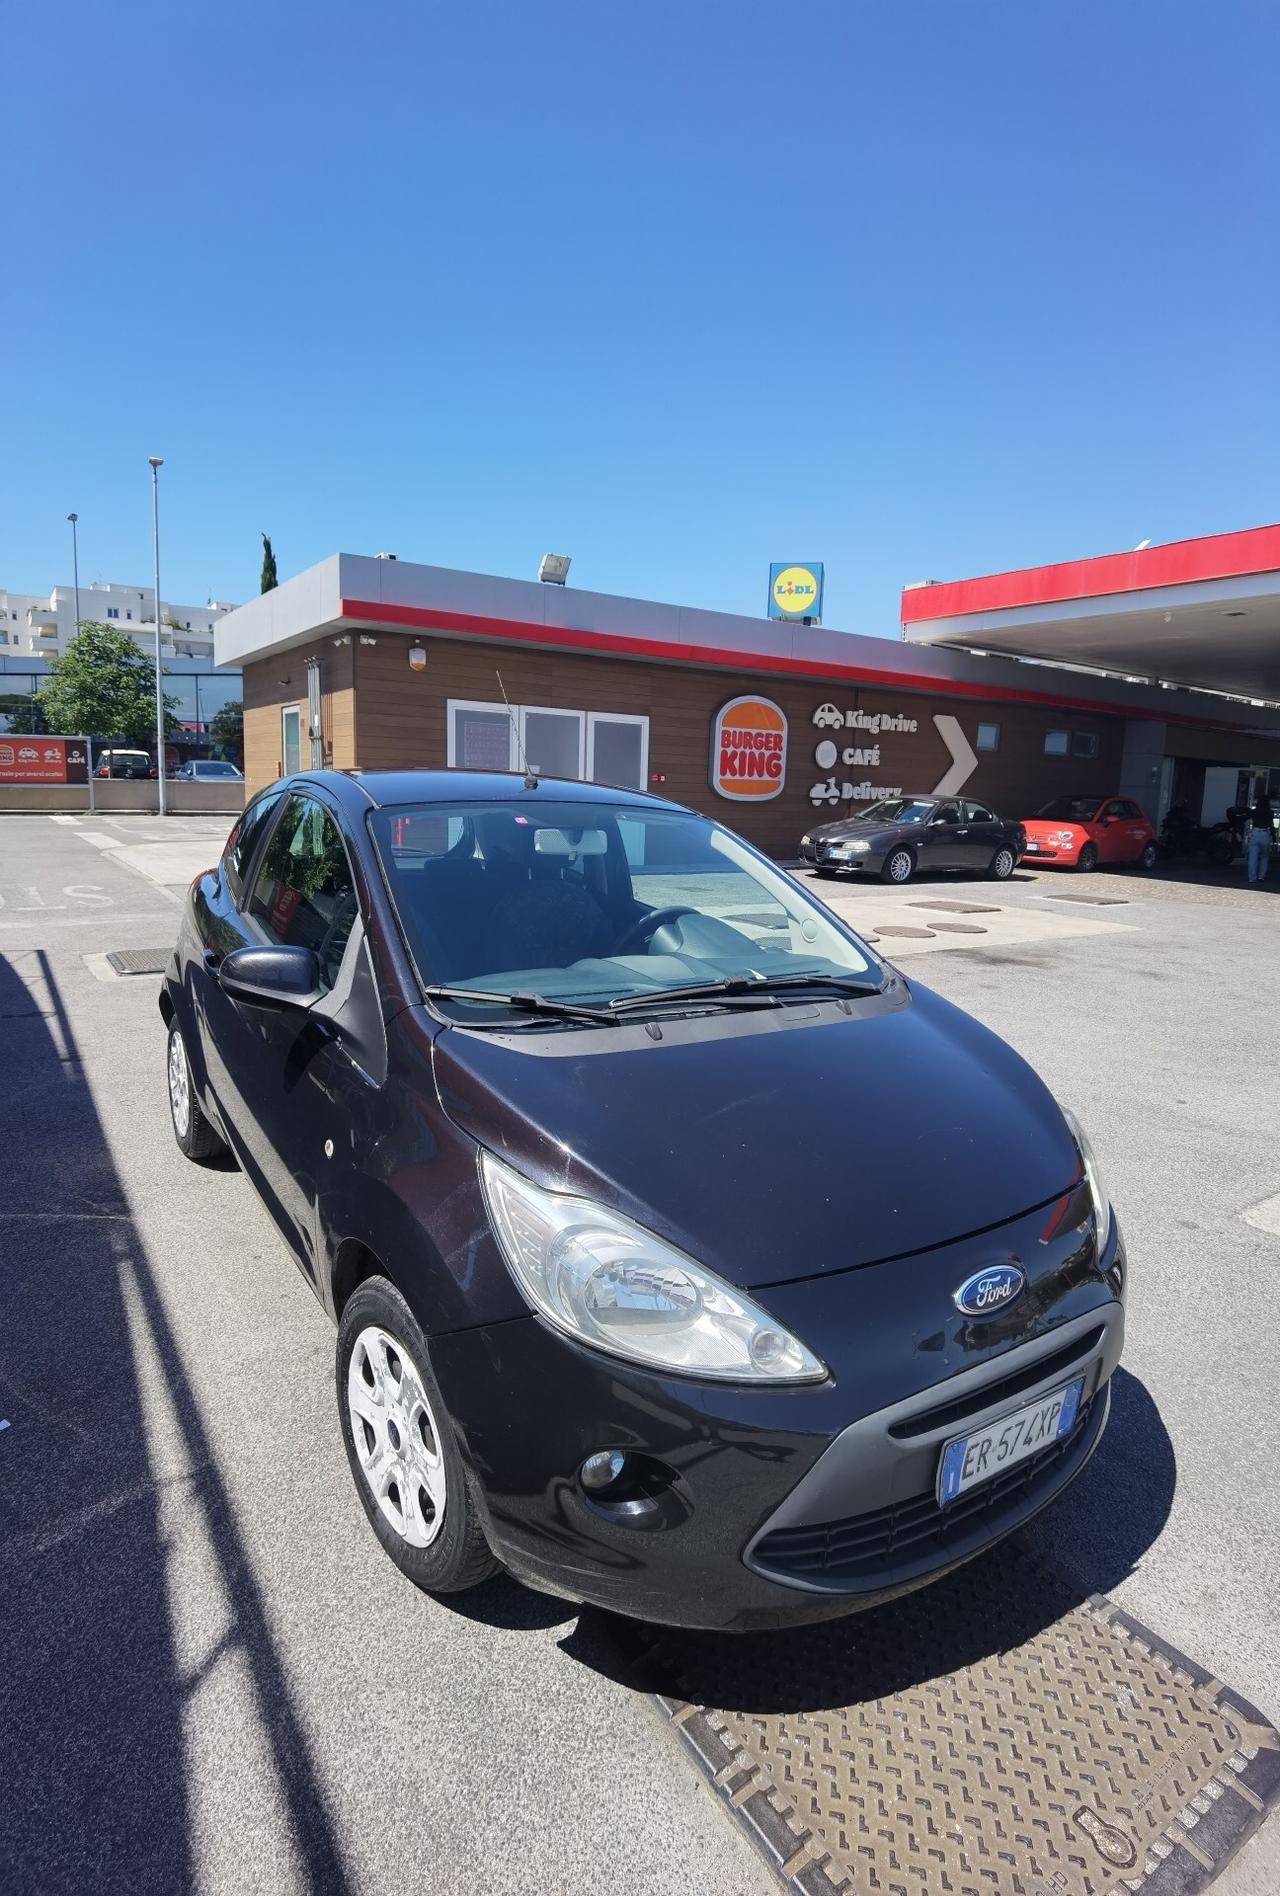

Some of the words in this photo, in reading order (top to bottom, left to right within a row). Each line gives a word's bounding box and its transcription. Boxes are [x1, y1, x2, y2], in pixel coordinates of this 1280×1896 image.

[721, 730, 783, 752] BURGER
[720, 750, 782, 778] KING
[842, 744, 880, 766] CAFÉ
[841, 782, 902, 801] Delivery
[976, 1275, 1012, 1307] Ford
